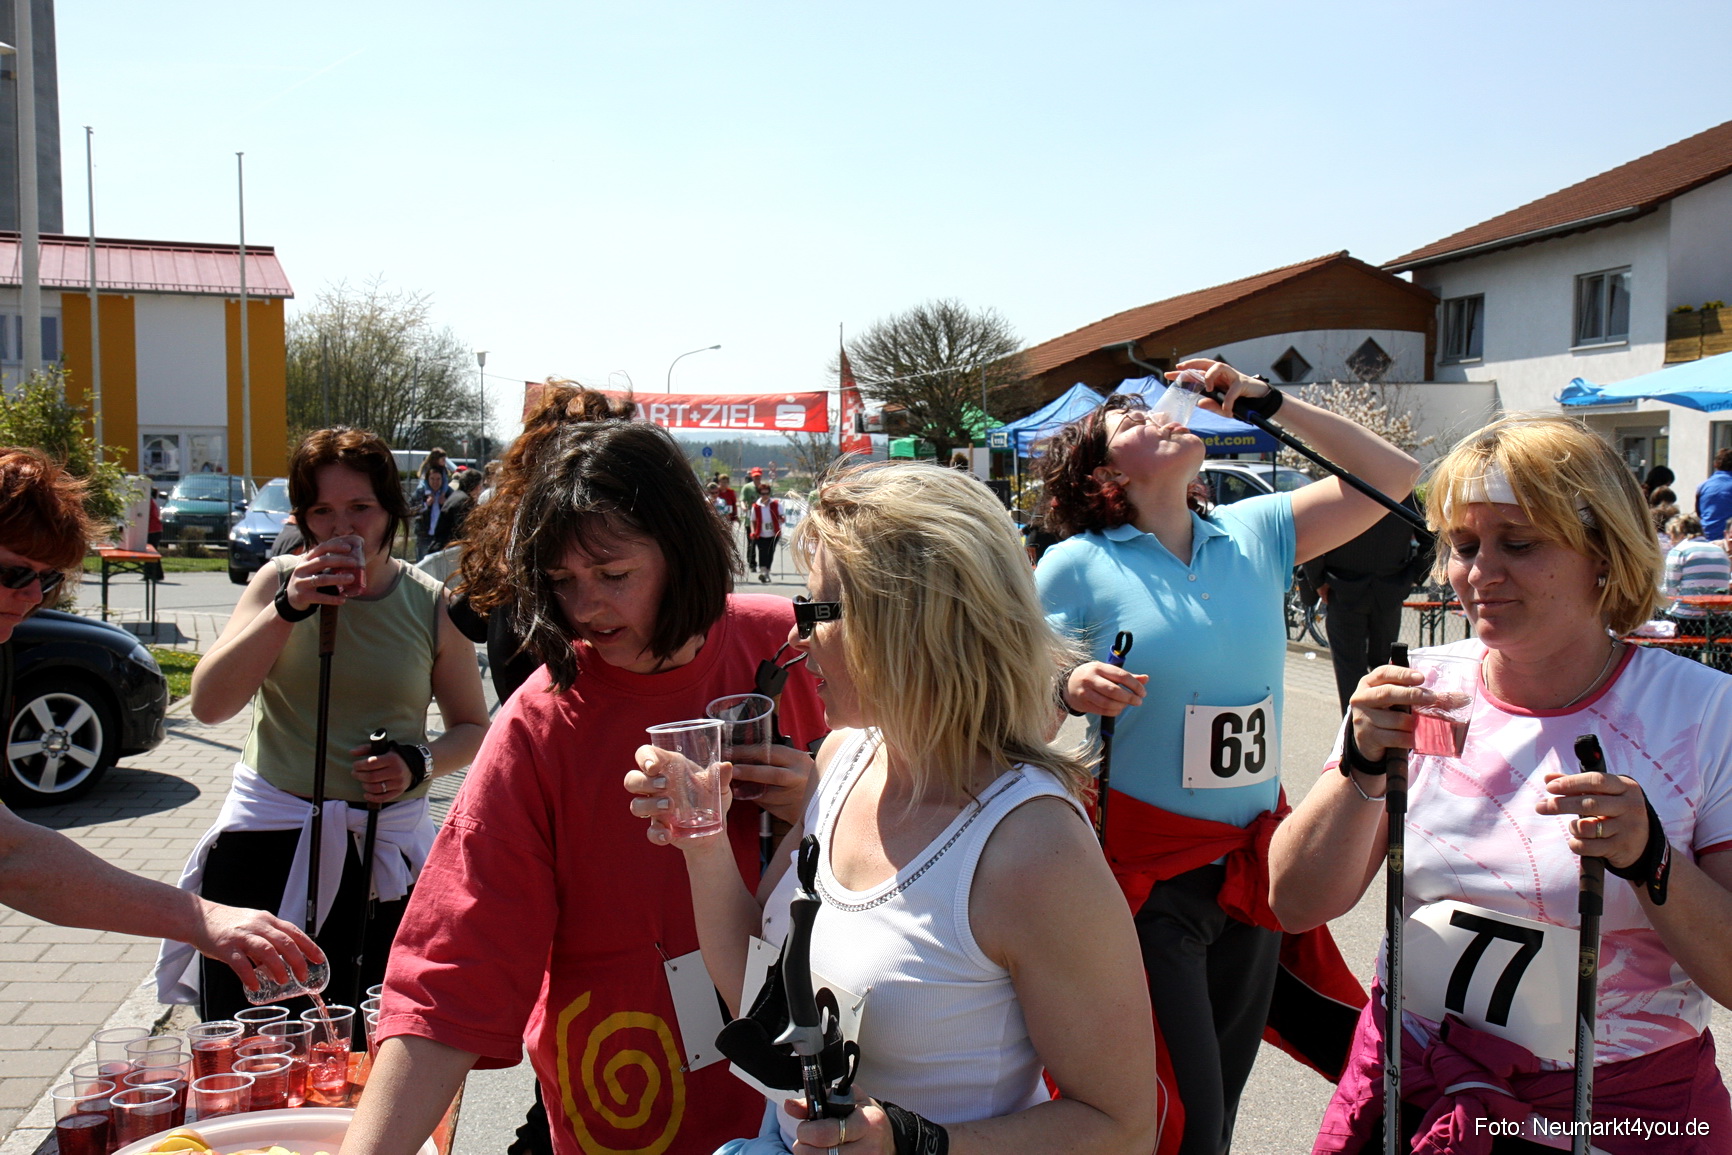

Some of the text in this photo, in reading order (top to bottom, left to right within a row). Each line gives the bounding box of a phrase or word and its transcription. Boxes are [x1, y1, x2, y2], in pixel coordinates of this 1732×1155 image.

[633, 403, 764, 427] ART+ZIEL
[1210, 708, 1266, 778] 63
[1444, 909, 1545, 1028] 77
